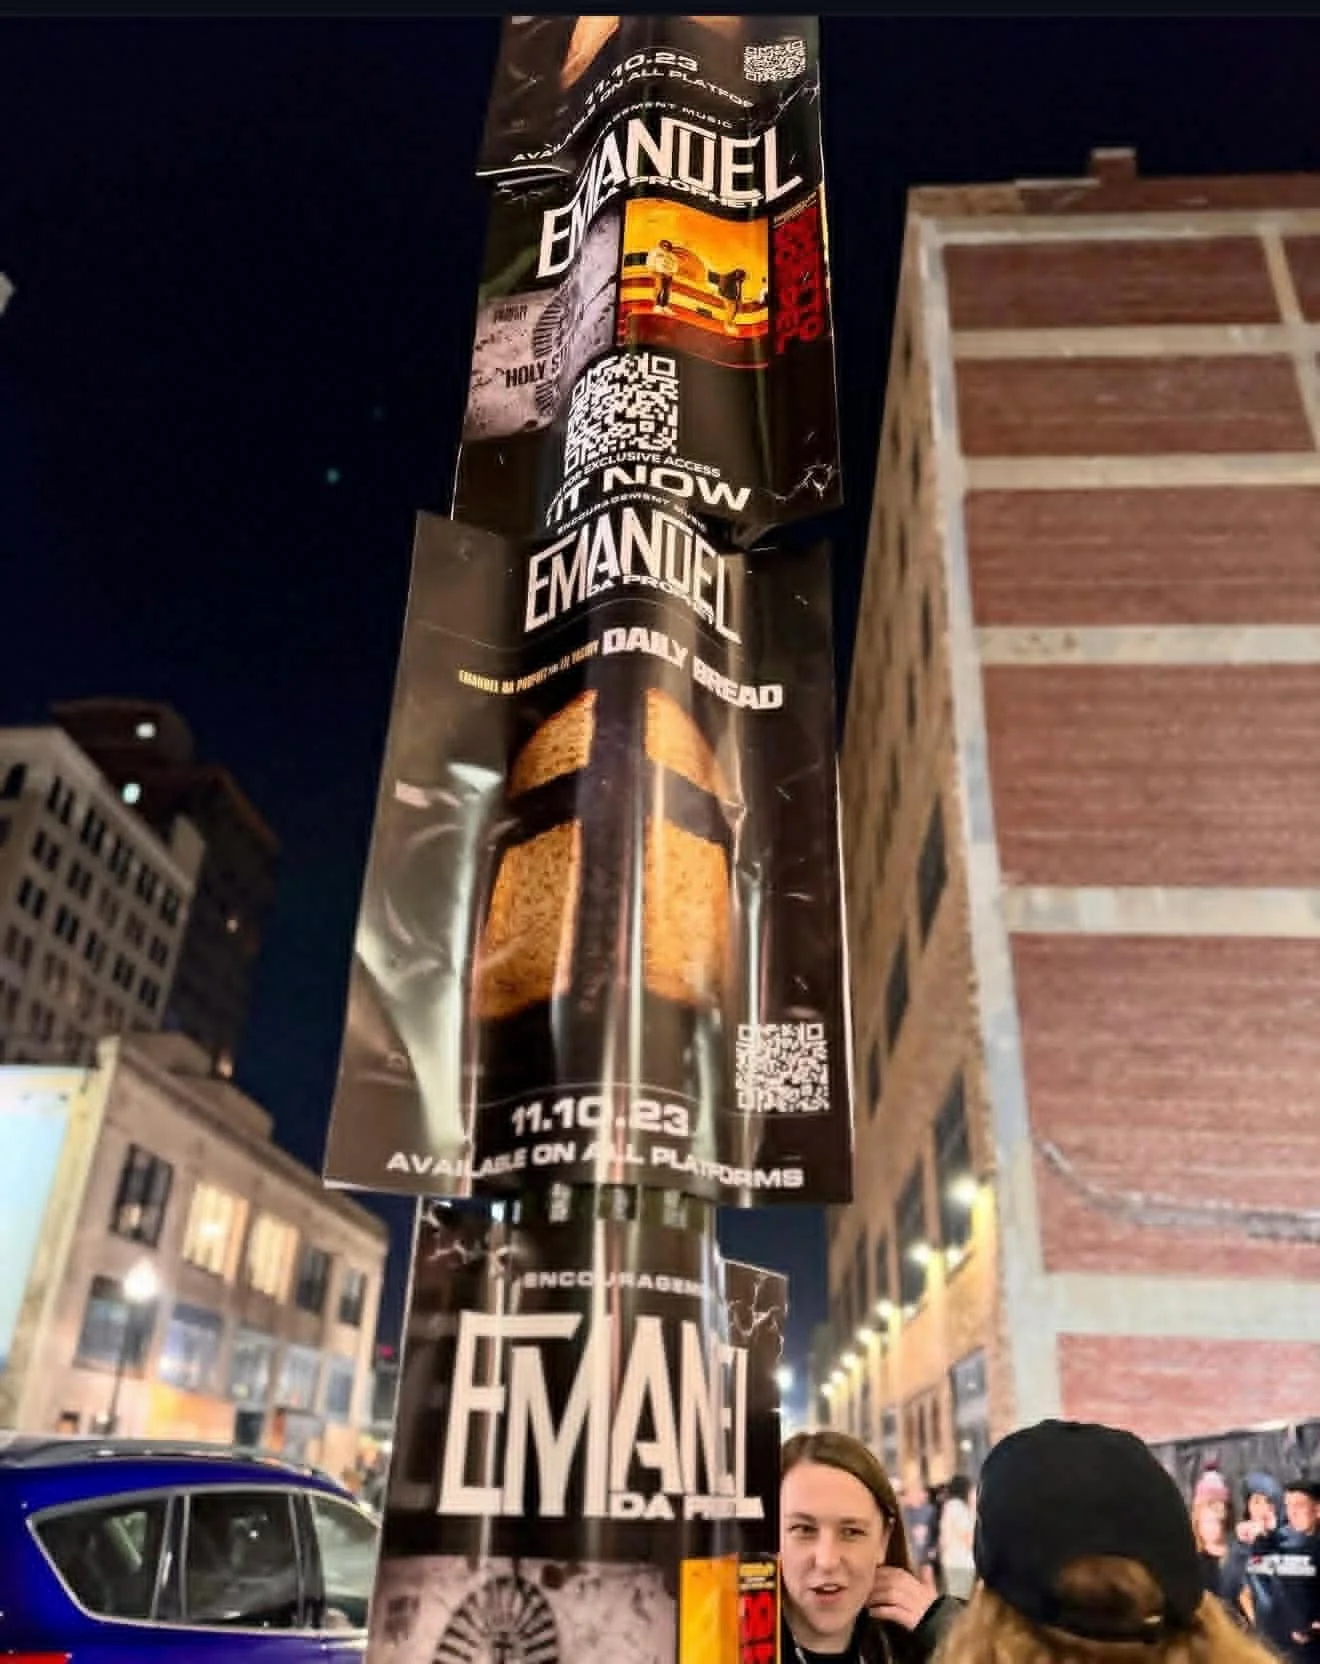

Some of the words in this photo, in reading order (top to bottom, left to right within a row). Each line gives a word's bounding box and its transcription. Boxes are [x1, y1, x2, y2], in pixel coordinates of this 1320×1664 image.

[627, 67, 665, 83] ALL
[682, 106, 734, 129] MUSIC
[505, 360, 546, 389] HOLY
[583, 452, 661, 475] EXCLUSIVE
[663, 455, 721, 478] ACCESS
[602, 464, 751, 512] NOW
[601, 627, 688, 669] DAILY
[692, 655, 784, 710] BREAD
[511, 1095, 690, 1137] 11.10.23
[385, 1147, 526, 1180] AVAILABLE
[531, 1141, 576, 1166] ON
[581, 1141, 645, 1166] AL
[650, 1145, 805, 1189] PLATFORMS
[609, 1493, 676, 1520] DA
